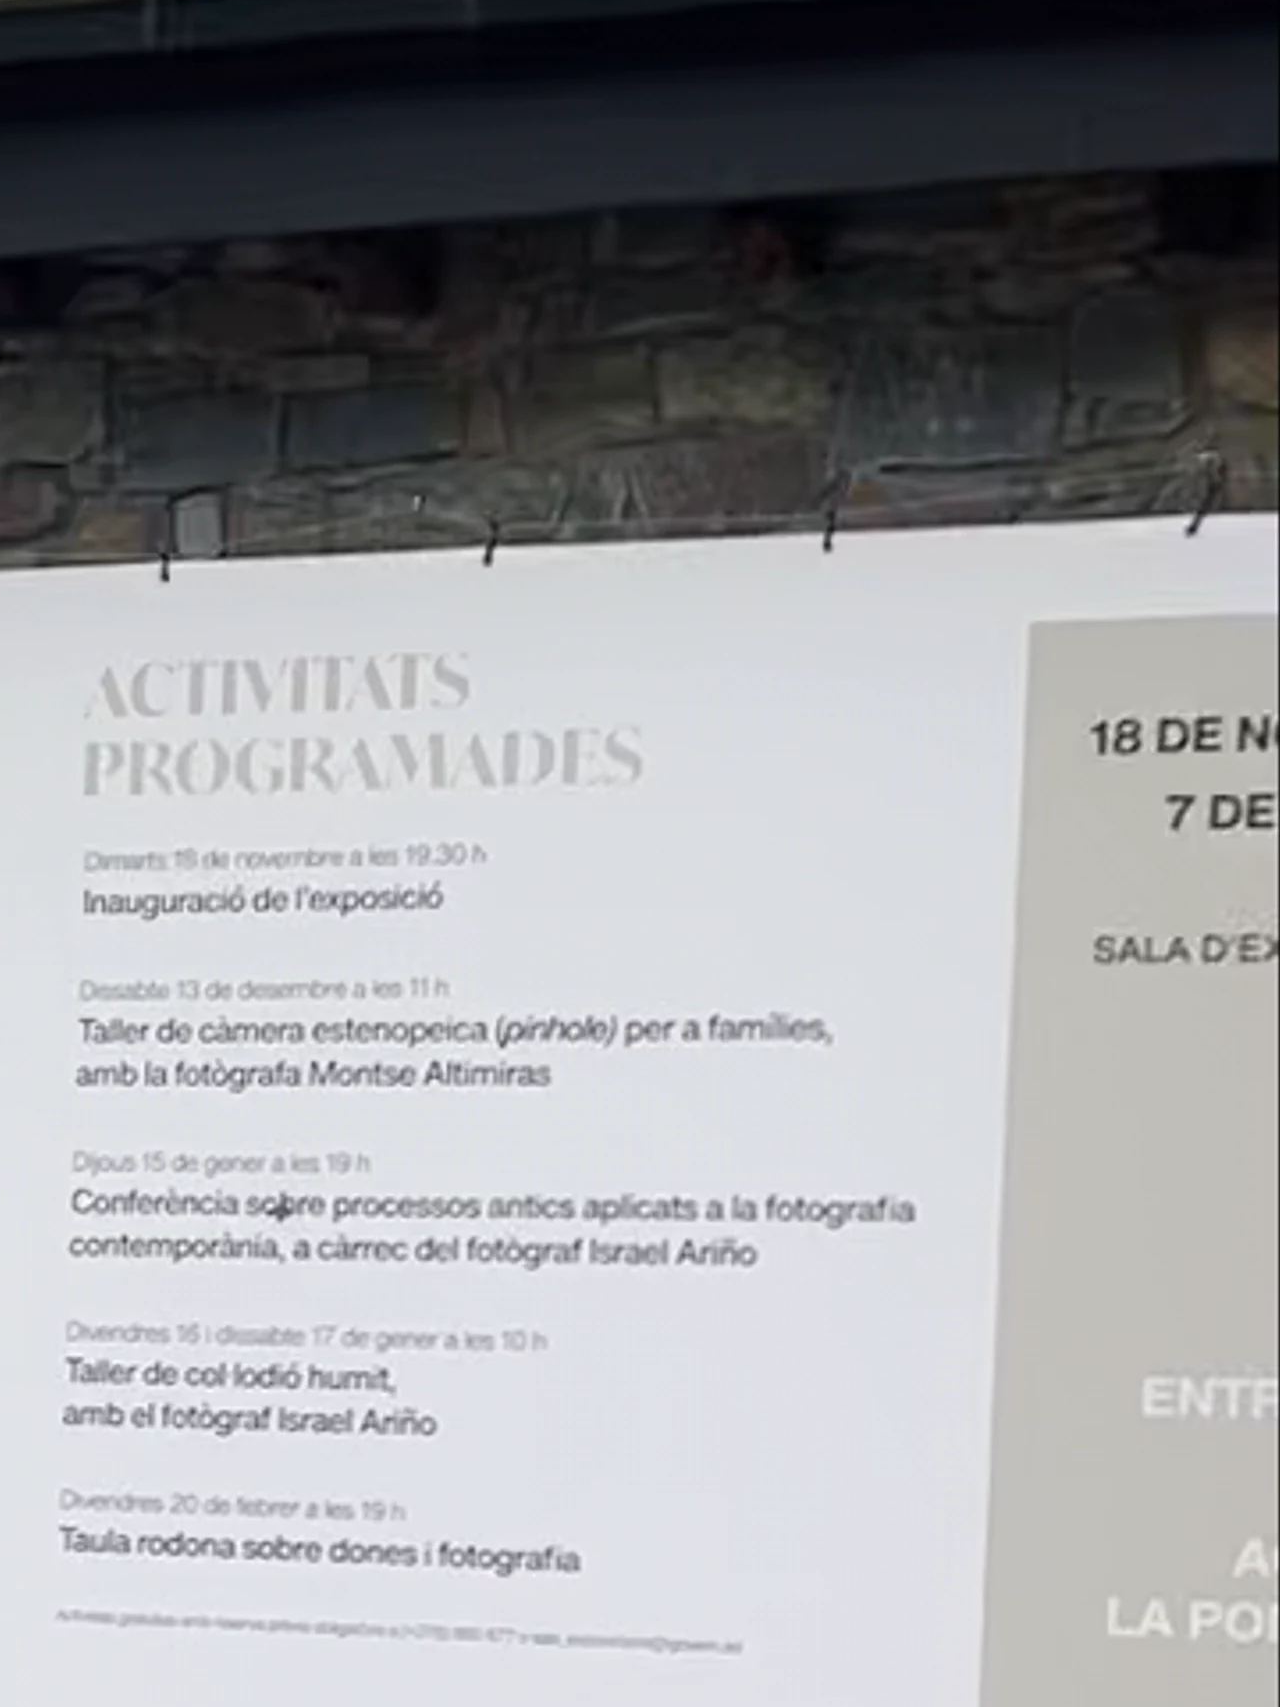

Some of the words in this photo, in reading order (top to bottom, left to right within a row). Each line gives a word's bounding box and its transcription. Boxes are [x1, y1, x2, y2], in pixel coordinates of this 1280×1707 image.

[83, 651, 470, 720] ACTIVITATS
[1090, 718, 1141, 756] 18
[1156, 716, 1223, 754] DE
[1237, 715, 1278, 752] N
[82, 725, 643, 797] PROGRAMADES
[1165, 794, 1197, 832] 7
[1209, 793, 1276, 830] DE
[83, 883, 247, 923] Inauguració
[251, 886, 290, 914] de
[294, 879, 445, 917] l'exposició
[1093, 934, 1191, 964] SALA
[77, 1017, 151, 1045] Taller
[155, 1017, 194, 1045] de
[197, 1015, 306, 1045] càmera
[310, 1017, 489, 1048] estenopeica
[494, 1014, 619, 1051] (pinhole)
[623, 1019, 677, 1048] per
[680, 1019, 702, 1042] a
[707, 1012, 833, 1045] famílies,
[75, 1061, 139, 1088] amb
[143, 1061, 168, 1088] la
[174, 1058, 303, 1094] fotògrafa
[308, 1060, 417, 1088] Montse
[422, 1058, 552, 1087] Altimiras
[70, 1187, 240, 1217] Conferència
[245, 1190, 327, 1224] sobre
[331, 1196, 483, 1224] processos
[487, 1194, 577, 1221] antics
[581, 1193, 699, 1226] aplicats
[704, 1199, 725, 1222] a
[731, 1194, 759, 1222] la
[764, 1193, 917, 1231] fotografia
[68, 1231, 286, 1265] contemporània,
[291, 1238, 312, 1261] a
[315, 1233, 408, 1263] càrrec
[413, 1236, 460, 1264] del
[466, 1236, 584, 1272] fotògraf
[588, 1238, 670, 1267] Israel
[674, 1237, 759, 1268] Ariño
[65, 1355, 138, 1386] Taller
[141, 1360, 179, 1387] de
[307, 1363, 397, 1395] humit,
[61, 1402, 126, 1428] amb
[130, 1402, 156, 1429] el
[161, 1402, 273, 1439] fotògraf
[277, 1406, 355, 1435] Israel
[359, 1406, 438, 1437] Ariño
[58, 1524, 132, 1555] Taula
[136, 1531, 237, 1560] rodona
[241, 1535, 324, 1564] sobre
[327, 1538, 419, 1568] dones
[437, 1541, 582, 1579] fotografia
[1231, 1538, 1278, 1579] A
[1107, 1595, 1175, 1638] LA
